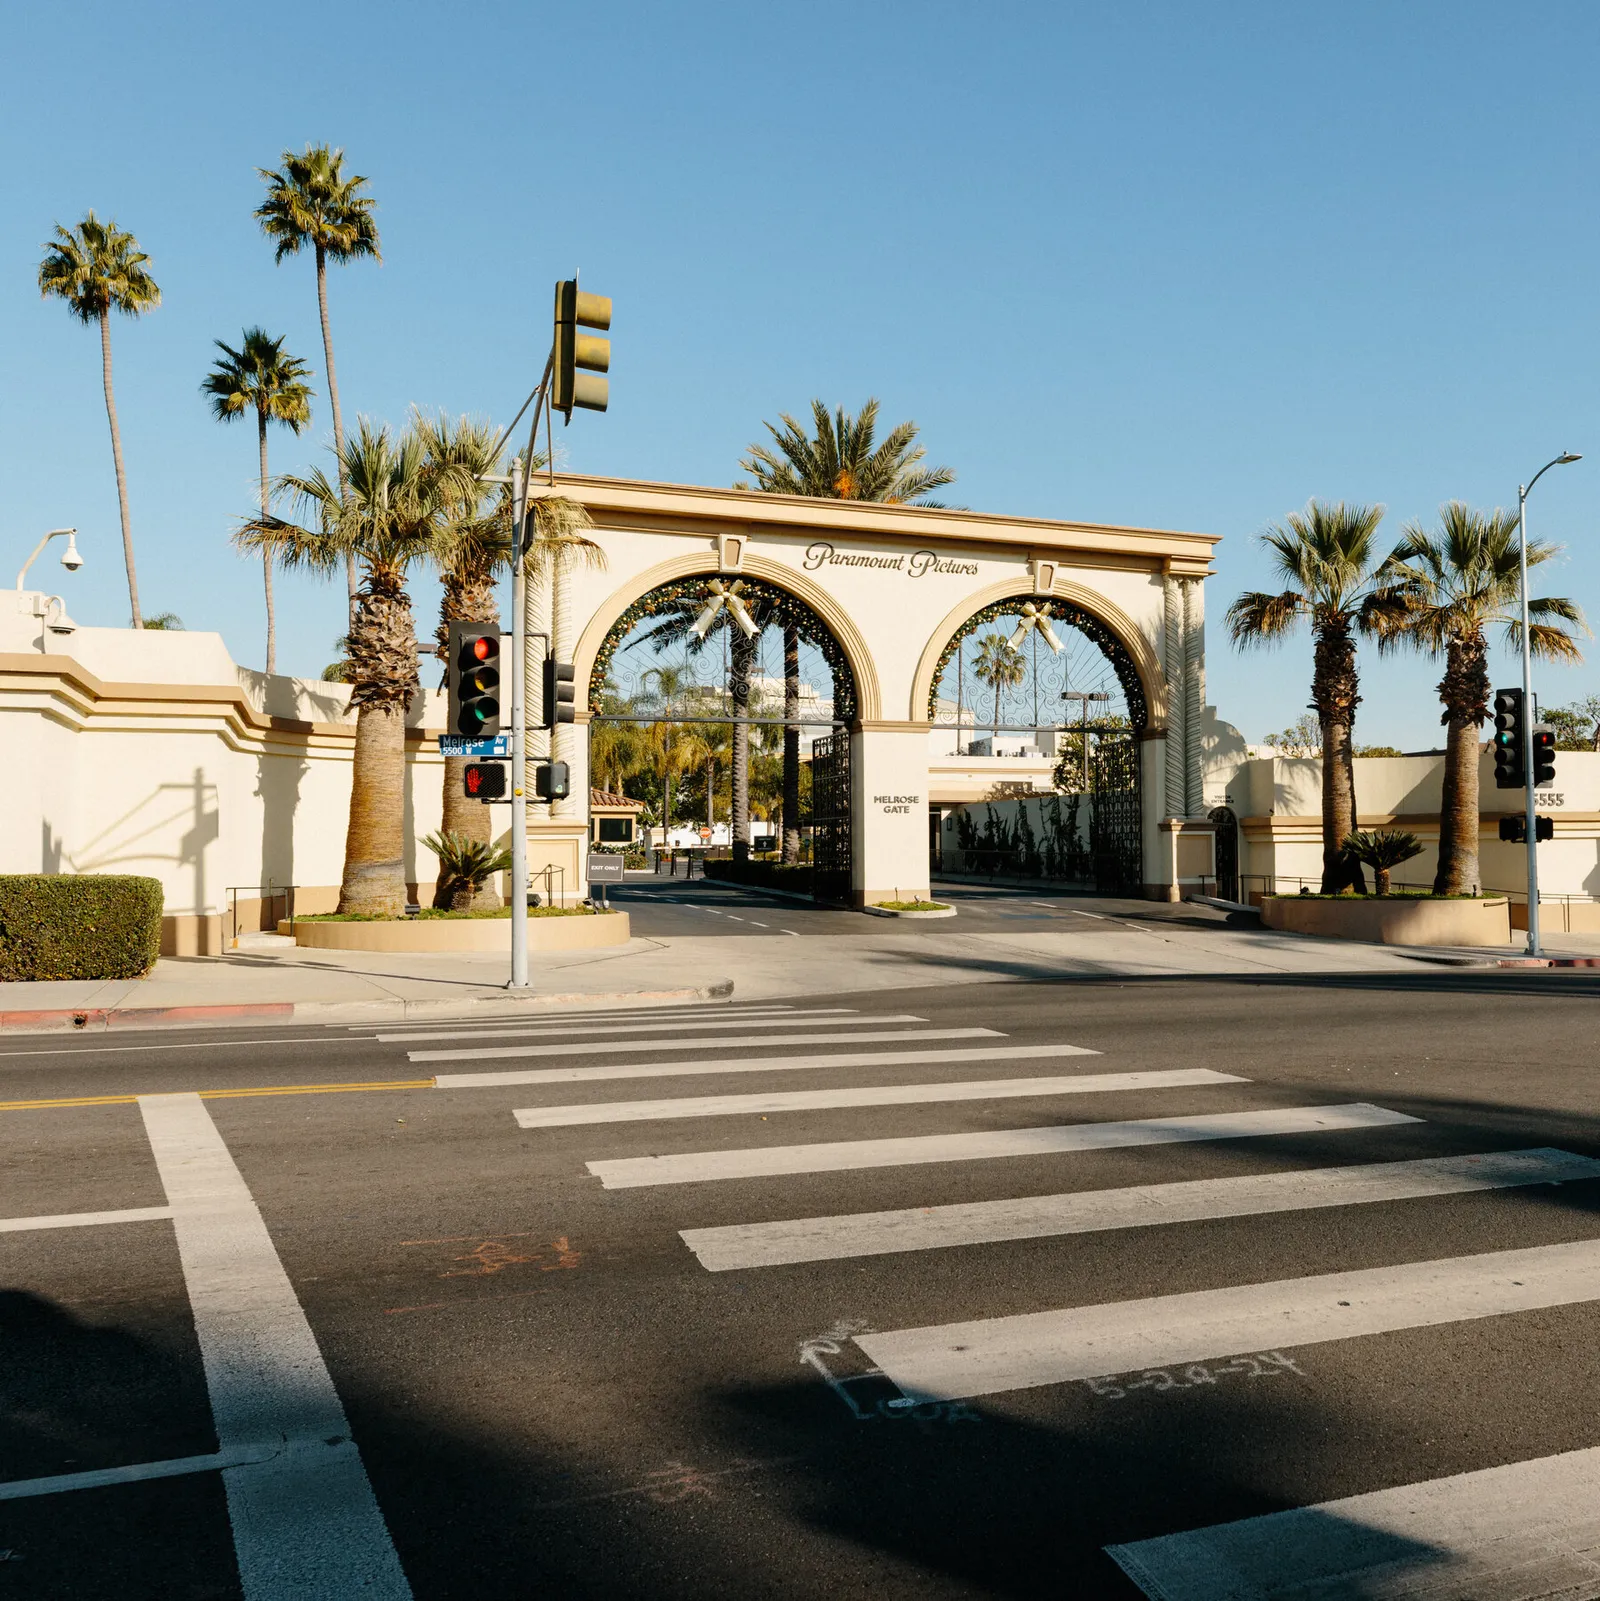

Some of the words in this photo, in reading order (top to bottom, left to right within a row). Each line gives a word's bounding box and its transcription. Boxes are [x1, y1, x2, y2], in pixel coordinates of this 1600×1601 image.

[802, 542, 905, 571] Paramount
[907, 550, 978, 578] Pictures
[442, 735, 485, 748] Melrose
[442, 746, 463, 755] 5500
[465, 747, 473, 755] W
[873, 795, 920, 804] MELROSE
[883, 805, 911, 814] GATE
